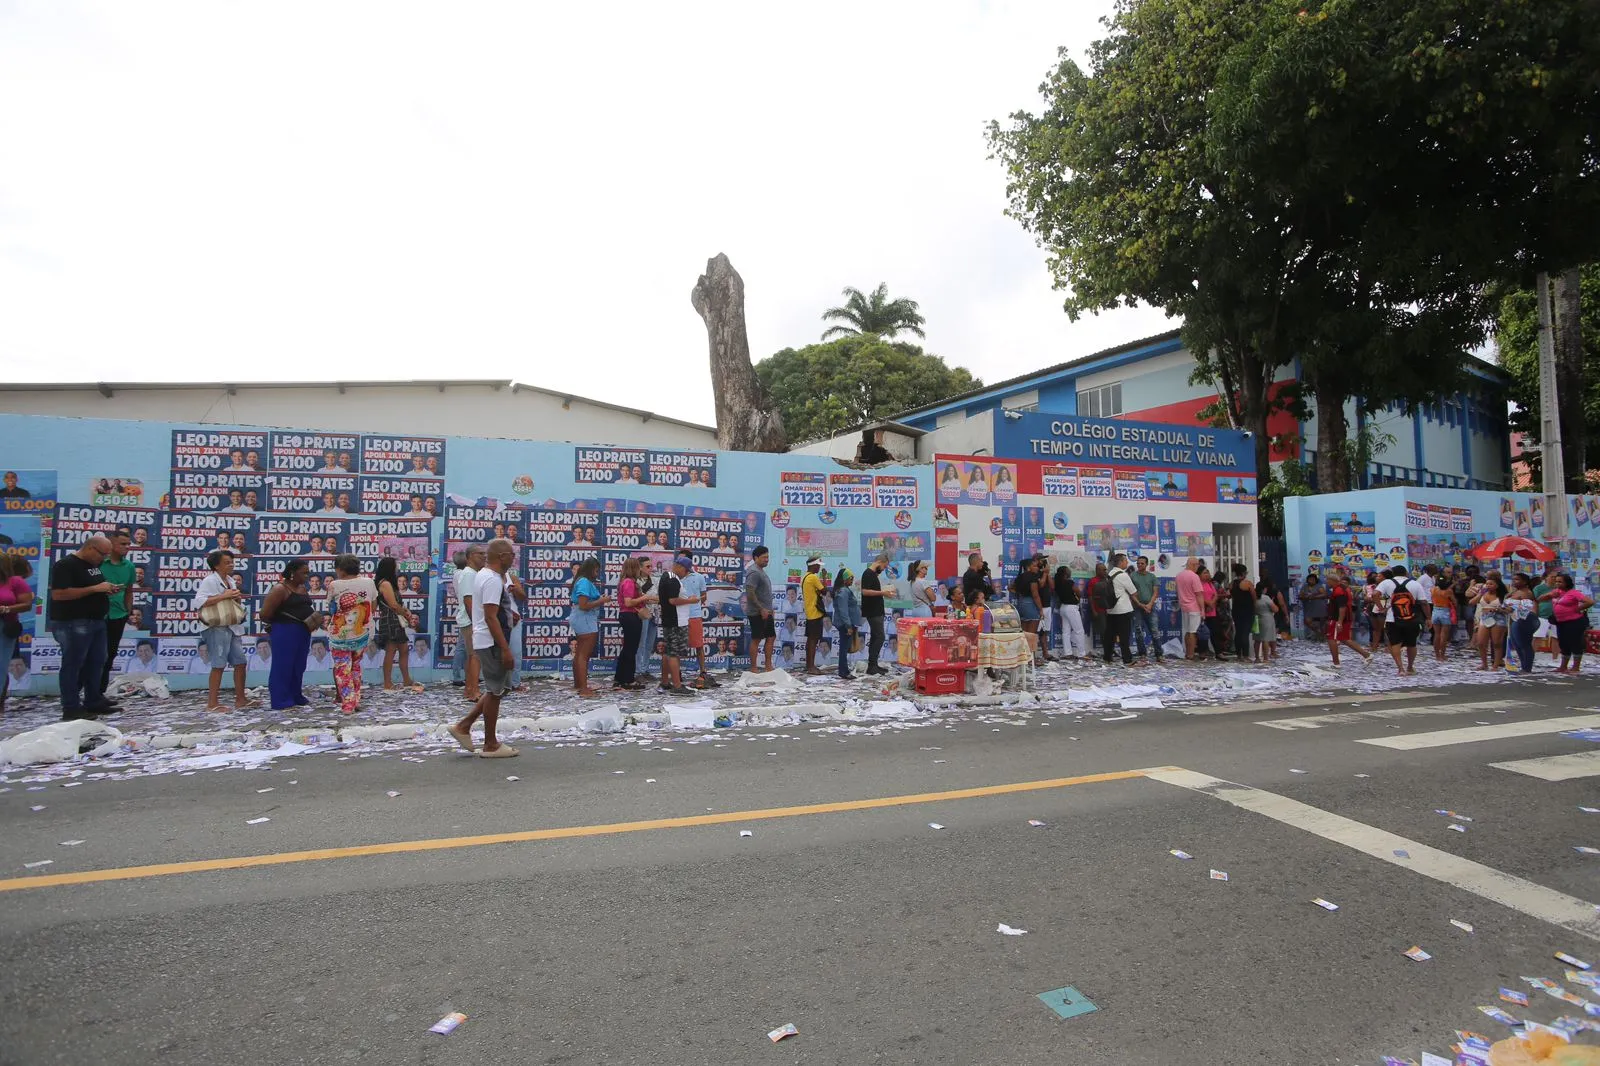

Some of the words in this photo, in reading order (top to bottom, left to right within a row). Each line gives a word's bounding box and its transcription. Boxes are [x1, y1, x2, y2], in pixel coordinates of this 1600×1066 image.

[1051, 420, 1116, 440] COLÉGIO
[1122, 428, 1193, 446] ESTADUAL
[1198, 434, 1215, 448] DE
[177, 434, 207, 446] LEO
[210, 435, 263, 448] PRATES
[305, 436, 355, 450] PRATES
[365, 439, 391, 451] LEO
[394, 440, 442, 453] PRATES
[204, 447, 229, 455] ZILTON
[389, 452, 411, 460] ZILTON
[579, 451, 603, 462] LEO
[604, 451, 645, 463] PRATES
[1030, 439, 1083, 456] TEMPO
[1089, 443, 1159, 461] INTEGRAL
[1163, 449, 1192, 463] LUIZ
[1196, 451, 1237, 466] VIANA
[176, 455, 221, 468] 12100
[273, 456, 315, 469] 12100
[364, 459, 404, 472] 12100
[650, 454, 672, 465] LEO
[674, 455, 713, 467] PRATES
[175, 474, 205, 486] LEO
[208, 475, 262, 487] PRATES
[579, 469, 613, 481] 12100
[650, 472, 682, 484] 12100
[303, 477, 354, 490] PRATES
[363, 480, 390, 492] LEO
[392, 482, 440, 494] PRATES
[1045, 484, 1076, 495] 12123
[1082, 485, 1111, 496] 12123
[1117, 488, 1145, 500] 12123
[4, 499, 56, 510] 10.000
[95, 495, 137, 505] 45045
[175, 495, 220, 509] 12100
[272, 497, 314, 510] 12100
[785, 492, 824, 505] 12123
[834, 494, 872, 506] 12123
[879, 495, 915, 507] 12123
[363, 500, 402, 513] 12100
[60, 507, 92, 521] LEO
[95, 509, 155, 525] PRATES
[448, 508, 473, 520] LEO
[476, 509, 522, 521] PRATES
[531, 511, 554, 523] LEO
[556, 512, 599, 525] PRATES
[58, 522, 84, 530] APOIA
[87, 522, 116, 531] ZILTON
[163, 514, 193, 527] LEO
[196, 516, 251, 529] PRATES
[260, 520, 288, 533] LEO
[291, 521, 342, 534] PRATES
[606, 516, 629, 527] LEO
[630, 518, 672, 529] PRATES
[680, 519, 702, 530] LEO
[703, 520, 742, 532] PRATES
[1407, 515, 1426, 527] 12123
[1430, 518, 1449, 529] 12123
[1452, 521, 1471, 531] 12123
[161, 528, 186, 536] APOIA
[189, 529, 216, 537] ZILTON
[350, 522, 377, 535] LEO
[379, 522, 428, 535] PRATES
[448, 528, 486, 540] 12100
[161, 536, 207, 550] 12100
[259, 533, 282, 541] APOIA
[530, 531, 565, 543] 12100
[606, 534, 639, 547] 12100
[745, 535, 761, 543] 0013
[258, 541, 300, 555] 12100
[350, 542, 379, 556] 1210
[680, 538, 711, 549] 12100
[529, 549, 552, 561] LEO
[554, 549, 598, 562] PRATES
[605, 553, 627, 564] LEO
[160, 557, 191, 569] LEO
[257, 560, 286, 573] LEO
[703, 556, 741, 568] PRATES
[529, 568, 564, 580] 12100
[528, 587, 551, 599] LEO
[157, 599, 187, 611] LEO
[528, 606, 563, 619] 12100
[526, 625, 550, 637] LEO
[702, 626, 741, 637] PRATES
[159, 648, 197, 657] 45500
[526, 644, 561, 656] 12100
